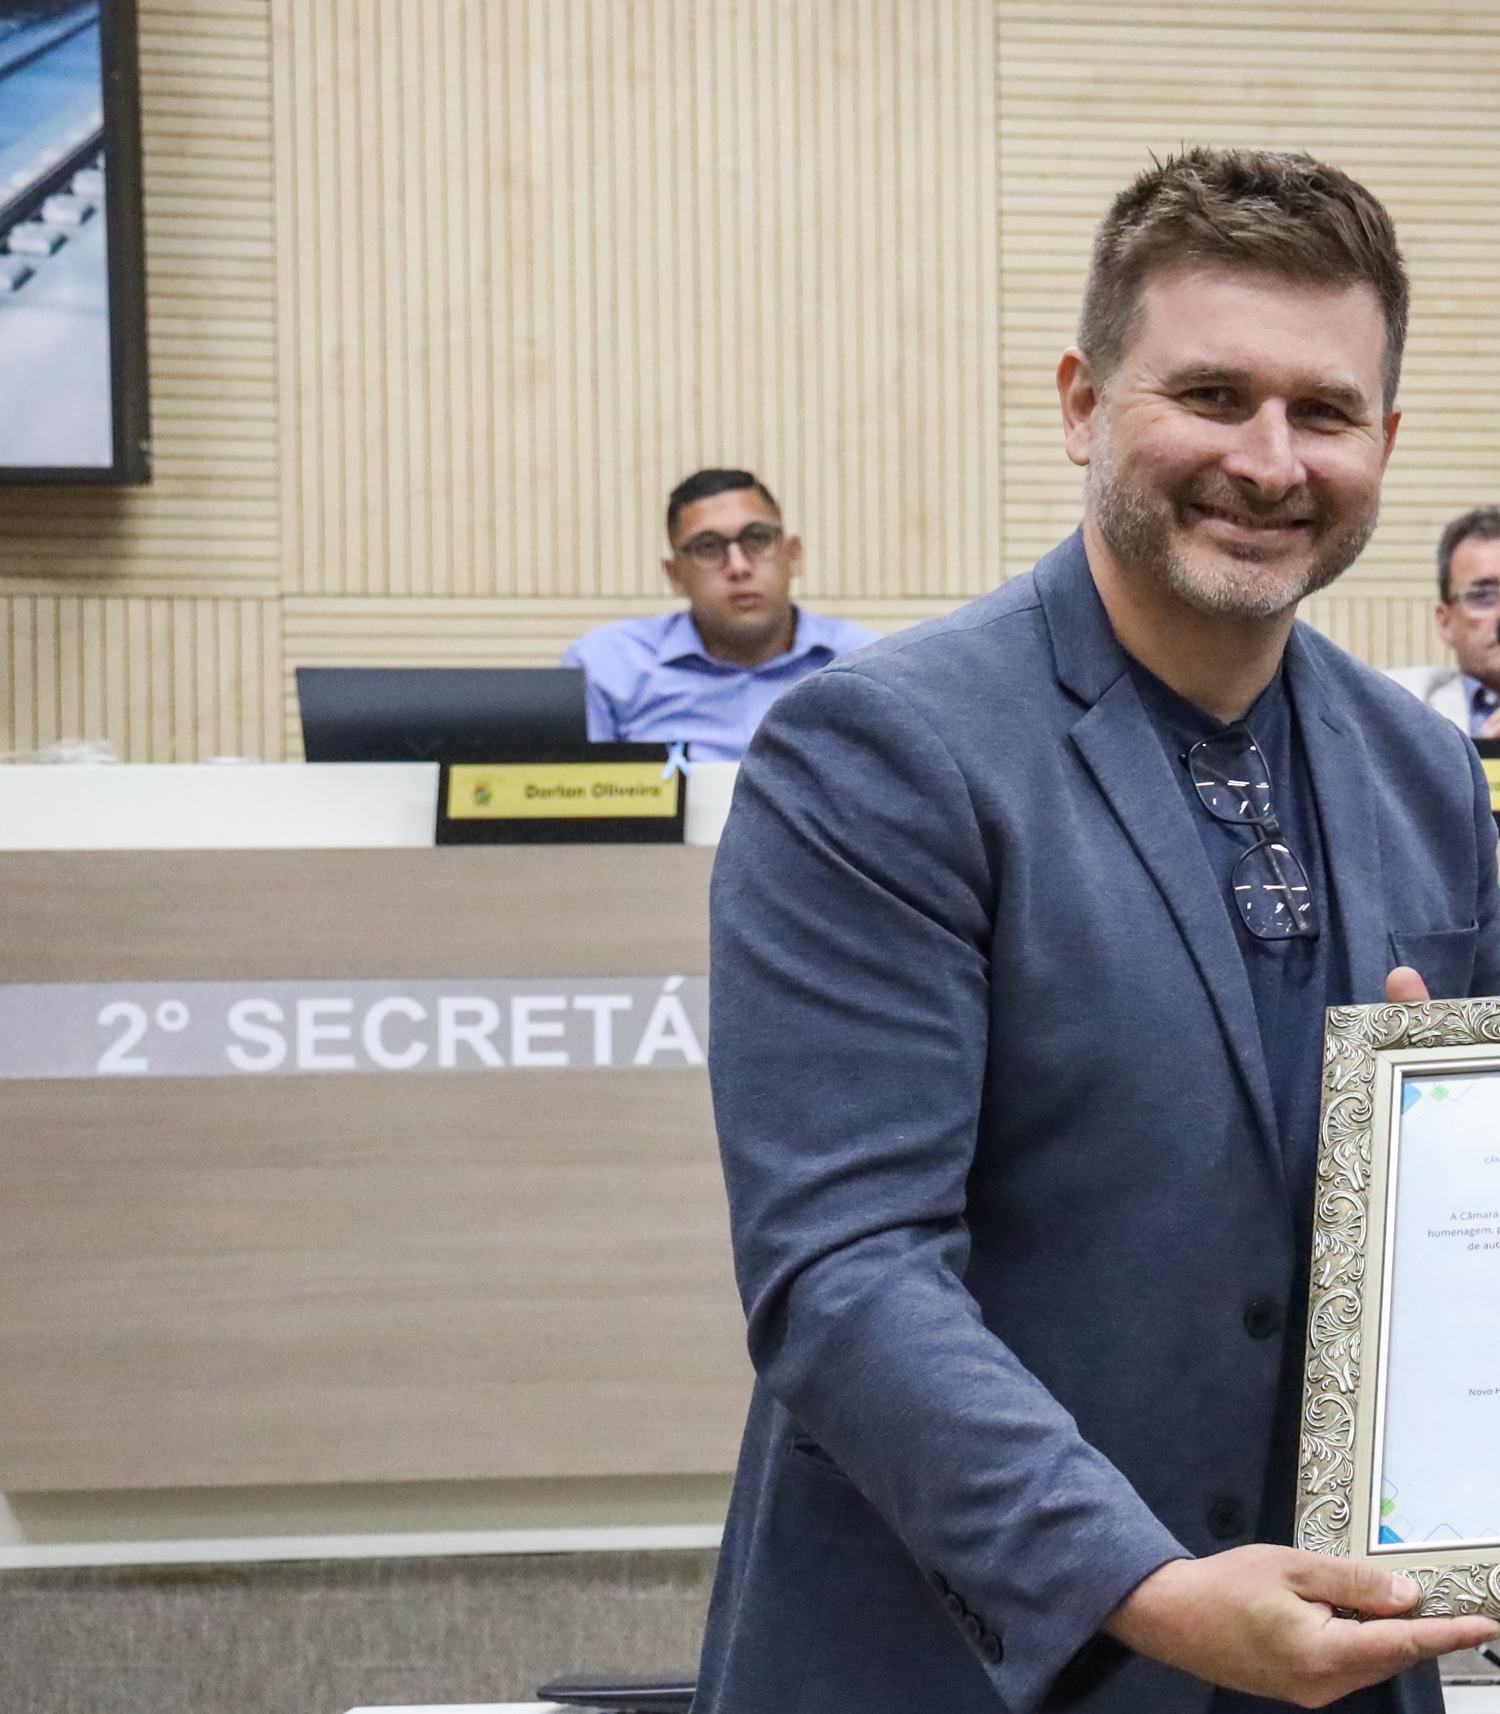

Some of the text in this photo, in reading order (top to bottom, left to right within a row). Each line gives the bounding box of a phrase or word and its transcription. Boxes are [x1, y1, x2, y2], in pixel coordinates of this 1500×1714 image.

[591, 783, 662, 798] Oliveira
[226, 976, 705, 1071] SECRETÁ
[1450, 1213, 1457, 1221] A
[1459, 1211, 1499, 1221] Câmara
[1427, 1227, 1493, 1238] homenagem,
[1467, 1242, 1480, 1251] de
[1468, 1387, 1493, 1396] Novo
